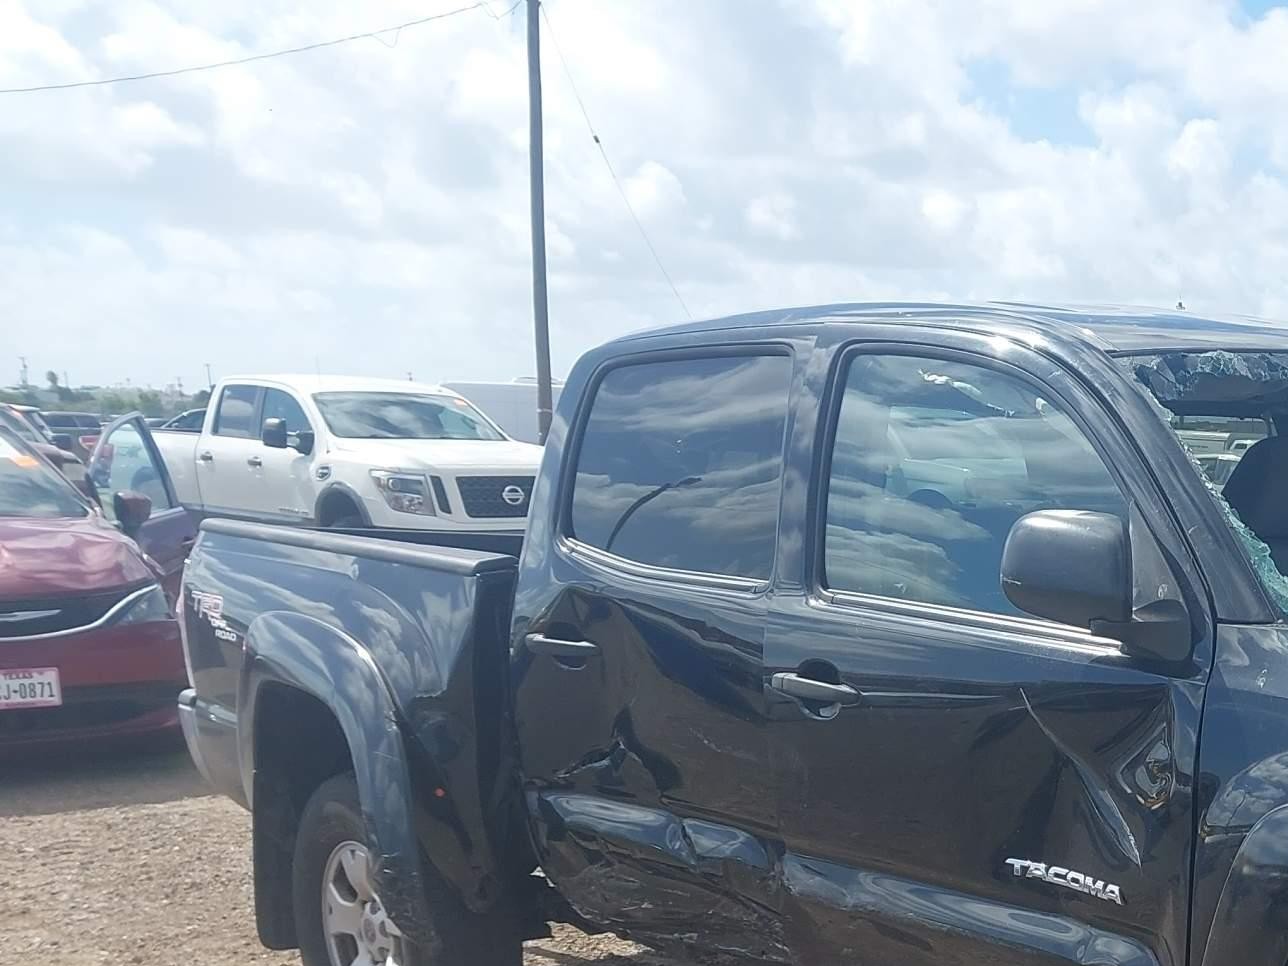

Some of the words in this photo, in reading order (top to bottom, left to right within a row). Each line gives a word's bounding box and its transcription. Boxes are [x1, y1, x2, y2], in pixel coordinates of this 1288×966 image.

[191, 590, 224, 618] TRD
[215, 629, 237, 642] ROAD
[2, 672, 33, 680] TEXAS
[0, 681, 55, 700] J-0871
[1004, 857, 1125, 906] TACOMA
